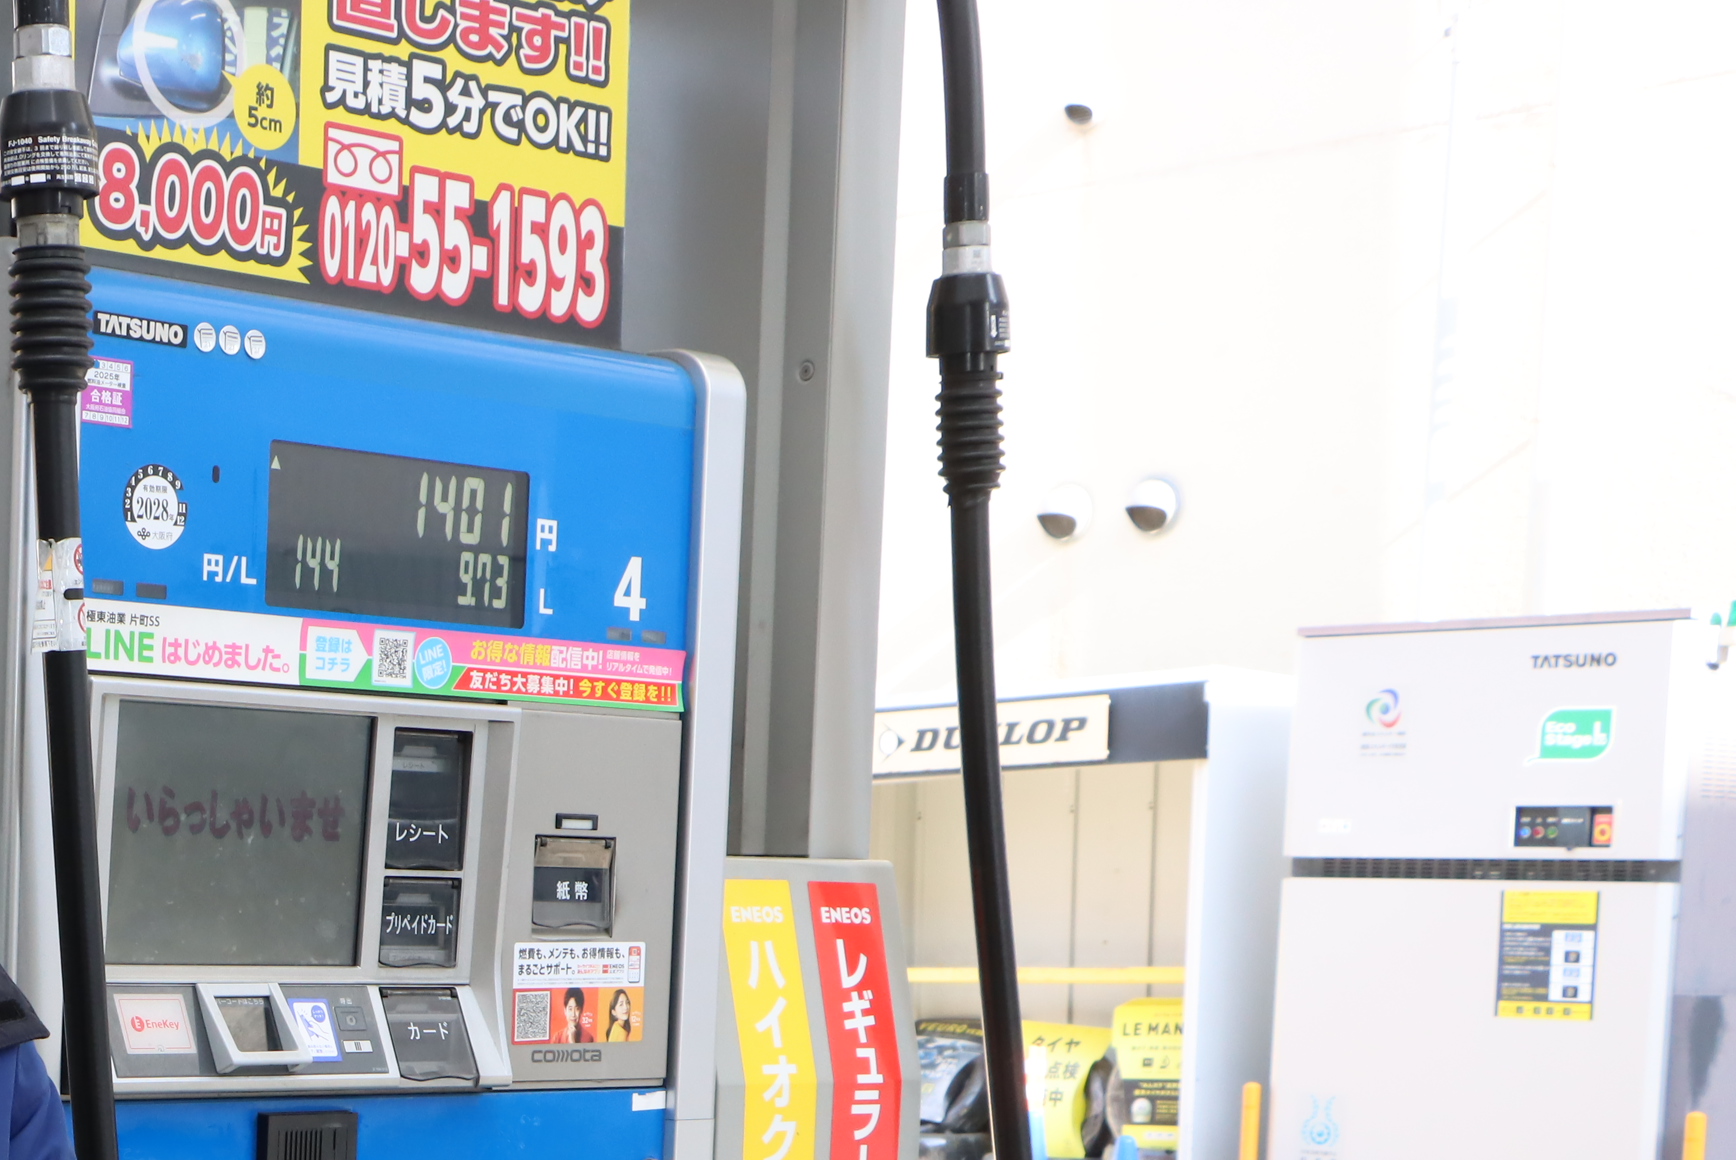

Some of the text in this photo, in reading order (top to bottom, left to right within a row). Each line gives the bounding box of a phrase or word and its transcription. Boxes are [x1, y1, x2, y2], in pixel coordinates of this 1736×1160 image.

[255, 81, 274, 109] 約
[324, 49, 610, 157] 見積5分でOK!!
[247, 107, 283, 133] 5cm
[8, 137, 33, 147] FJ-1040
[37, 135, 60, 144] Safety
[97, 142, 286, 258] 8,000円
[319, 167, 608, 328] 0120-55-1593
[97, 312, 184, 345] TATSUNO
[93, 370, 120, 381] 2025年
[90, 388, 123, 406] 合格証
[137, 469, 143, 479] 5
[147, 465, 153, 475] 6
[158, 466, 164, 476] 7
[167, 471, 173, 481] 8
[130, 476, 136, 486] 4
[143, 484, 168, 494] 有効期限
[175, 480, 181, 489] 9
[126, 487, 132, 497] 3
[125, 499, 131, 508] 2
[178, 503, 186, 513] 11
[417, 471, 513, 548] 1401
[176, 515, 185, 525] 12
[152, 531, 173, 541] 大阪府
[535, 518, 558, 552] 円
[202, 552, 257, 586] 円/L
[295, 534, 341, 592] 144
[613, 556, 647, 622] 4
[539, 588, 553, 615] L
[86, 610, 160, 628] 極東油業 片町SS
[86, 627, 155, 663] LINE
[162, 636, 290, 674] はじめました。
[315, 635, 353, 654] 登録は
[418, 644, 445, 665] LINE
[470, 639, 604, 671] お得な情報配信中!
[606, 649, 641, 662] 店舗情報を
[1530, 652, 1618, 670] TATSUNO
[314, 656, 351, 673] コチラ
[421, 661, 448, 682] 限定!
[606, 660, 673, 677] リアルタイムで発信中!
[469, 669, 673, 702] 友だち大募集中! 今すぐ登録を!!
[910, 716, 1088, 753] DULOP
[1545, 721, 1577, 734] Eco
[1544, 733, 1593, 749] Stage
[126, 786, 347, 842] いらっしゃいませ
[395, 821, 449, 844] レシート
[555, 879, 590, 902] 紙幣
[385, 911, 454, 935] プリペイドカード
[730, 905, 784, 923] ENEOS
[820, 906, 872, 924] ENEOS
[518, 947, 626, 960] 燃費も、メンテも、お得情報も、
[517, 961, 576, 976] まるごとサポート。
[145, 1018, 180, 1031] EneKey
[407, 1021, 449, 1040] カード
